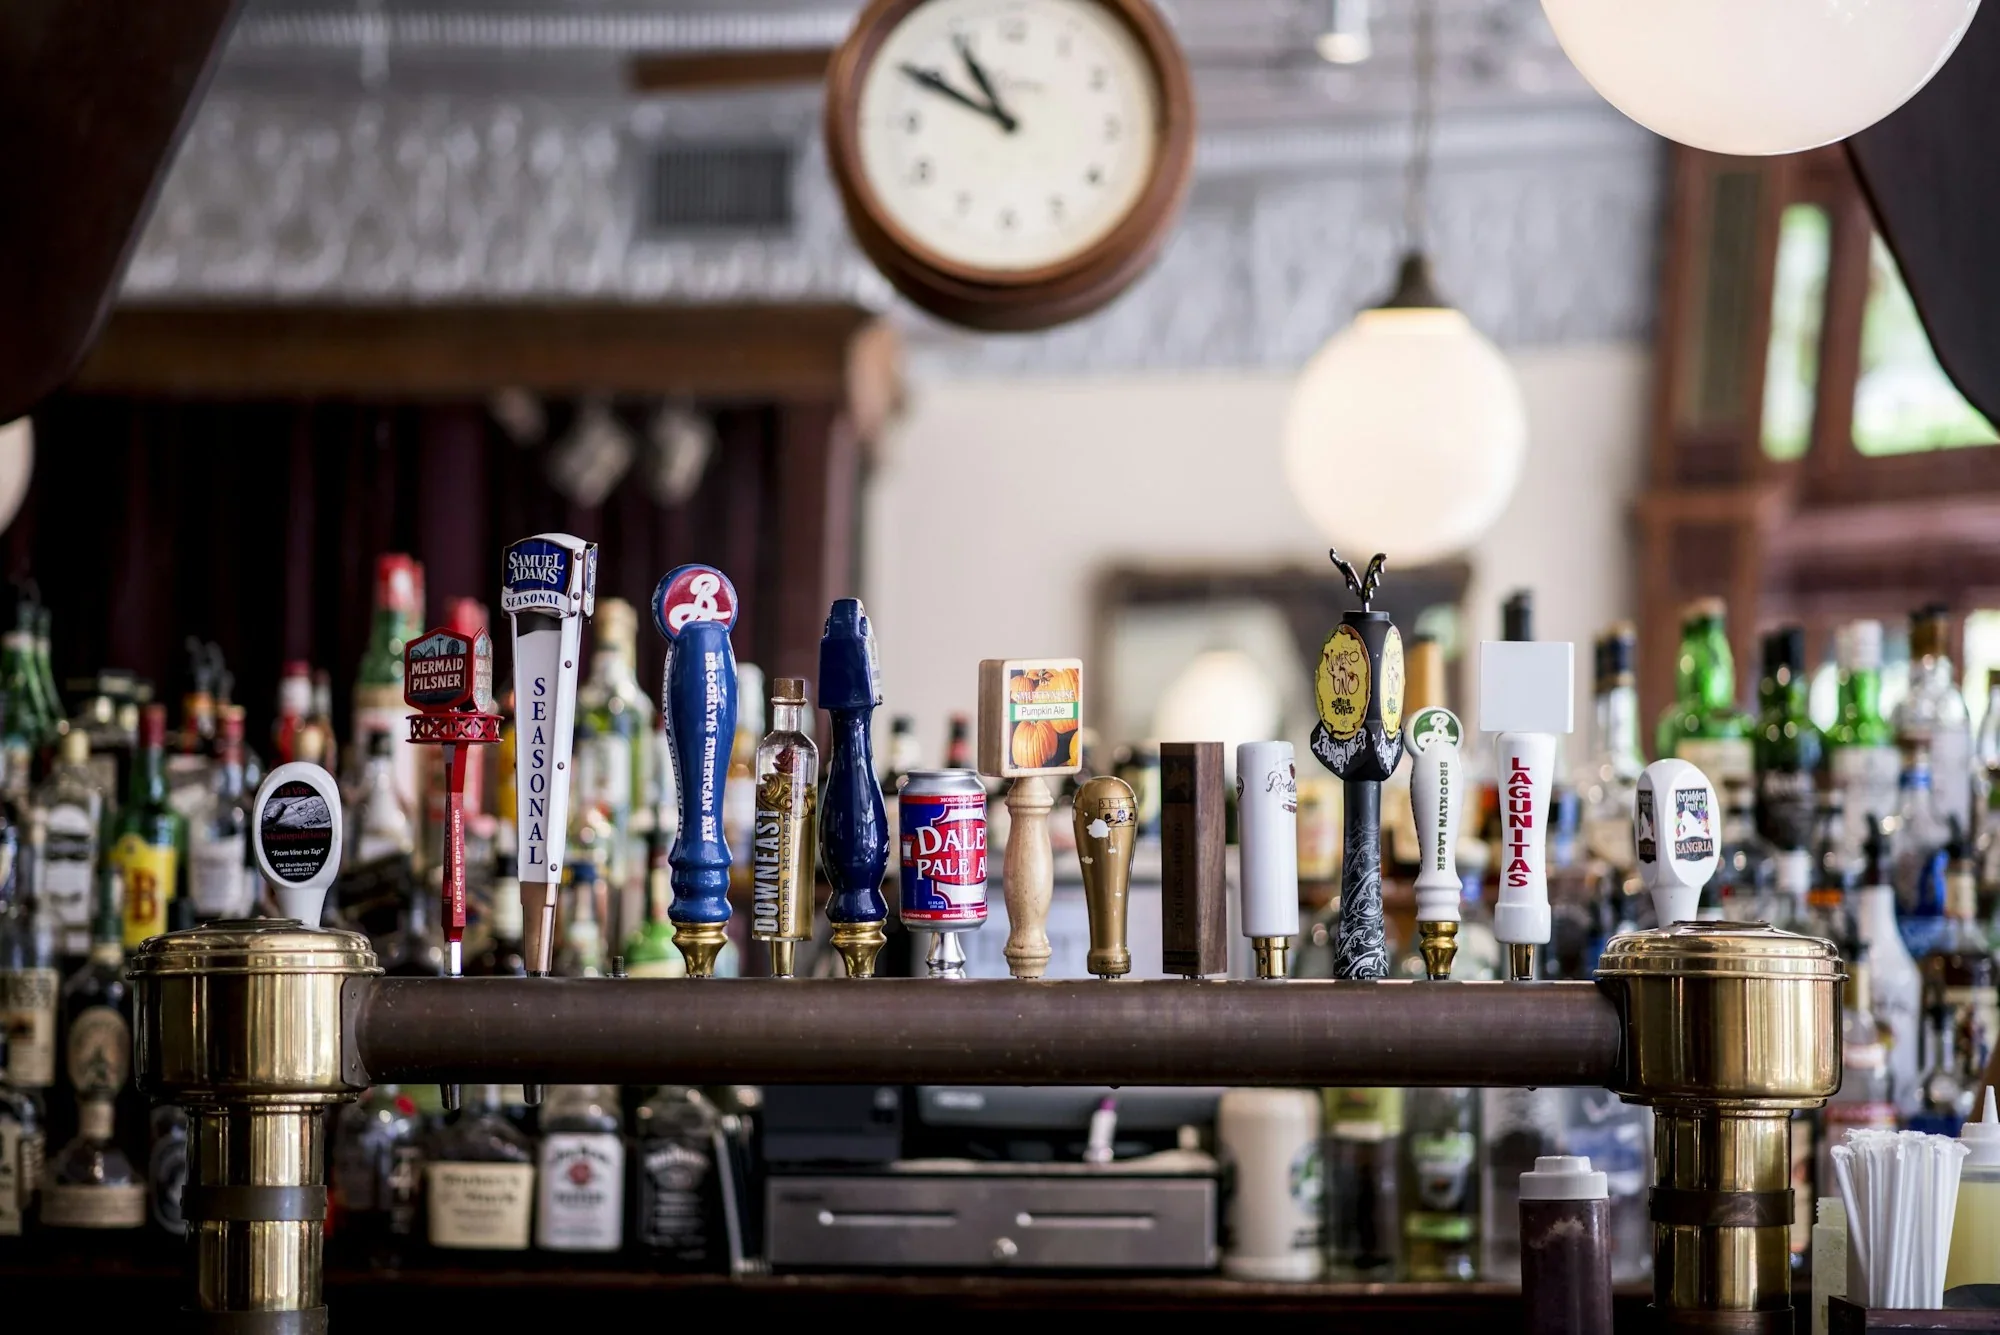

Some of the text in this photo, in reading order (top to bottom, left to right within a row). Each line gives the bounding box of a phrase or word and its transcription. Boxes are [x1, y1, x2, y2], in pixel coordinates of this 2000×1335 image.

[508, 551, 565, 570] SAMUEL
[510, 567, 558, 585] ADAMS
[505, 592, 560, 608] SEASONAL
[411, 658, 464, 675] MERMAID
[413, 673, 461, 691] PILSNER
[1021, 705, 1066, 717] Pumpkin Ale
[701, 652, 718, 843] BROOKLYN AMERICAN ALE
[528, 677, 547, 865] SEASONAL
[1437, 761, 1448, 872] BROOKLYN LAGER
[1506, 757, 1534, 888] LAGUNITAS
[1675, 840, 1712, 854] SANGRIA
[754, 807, 781, 933] DOWNEAST
[781, 812, 792, 933] CIDER HOUSE
[916, 858, 970, 881] PALE
